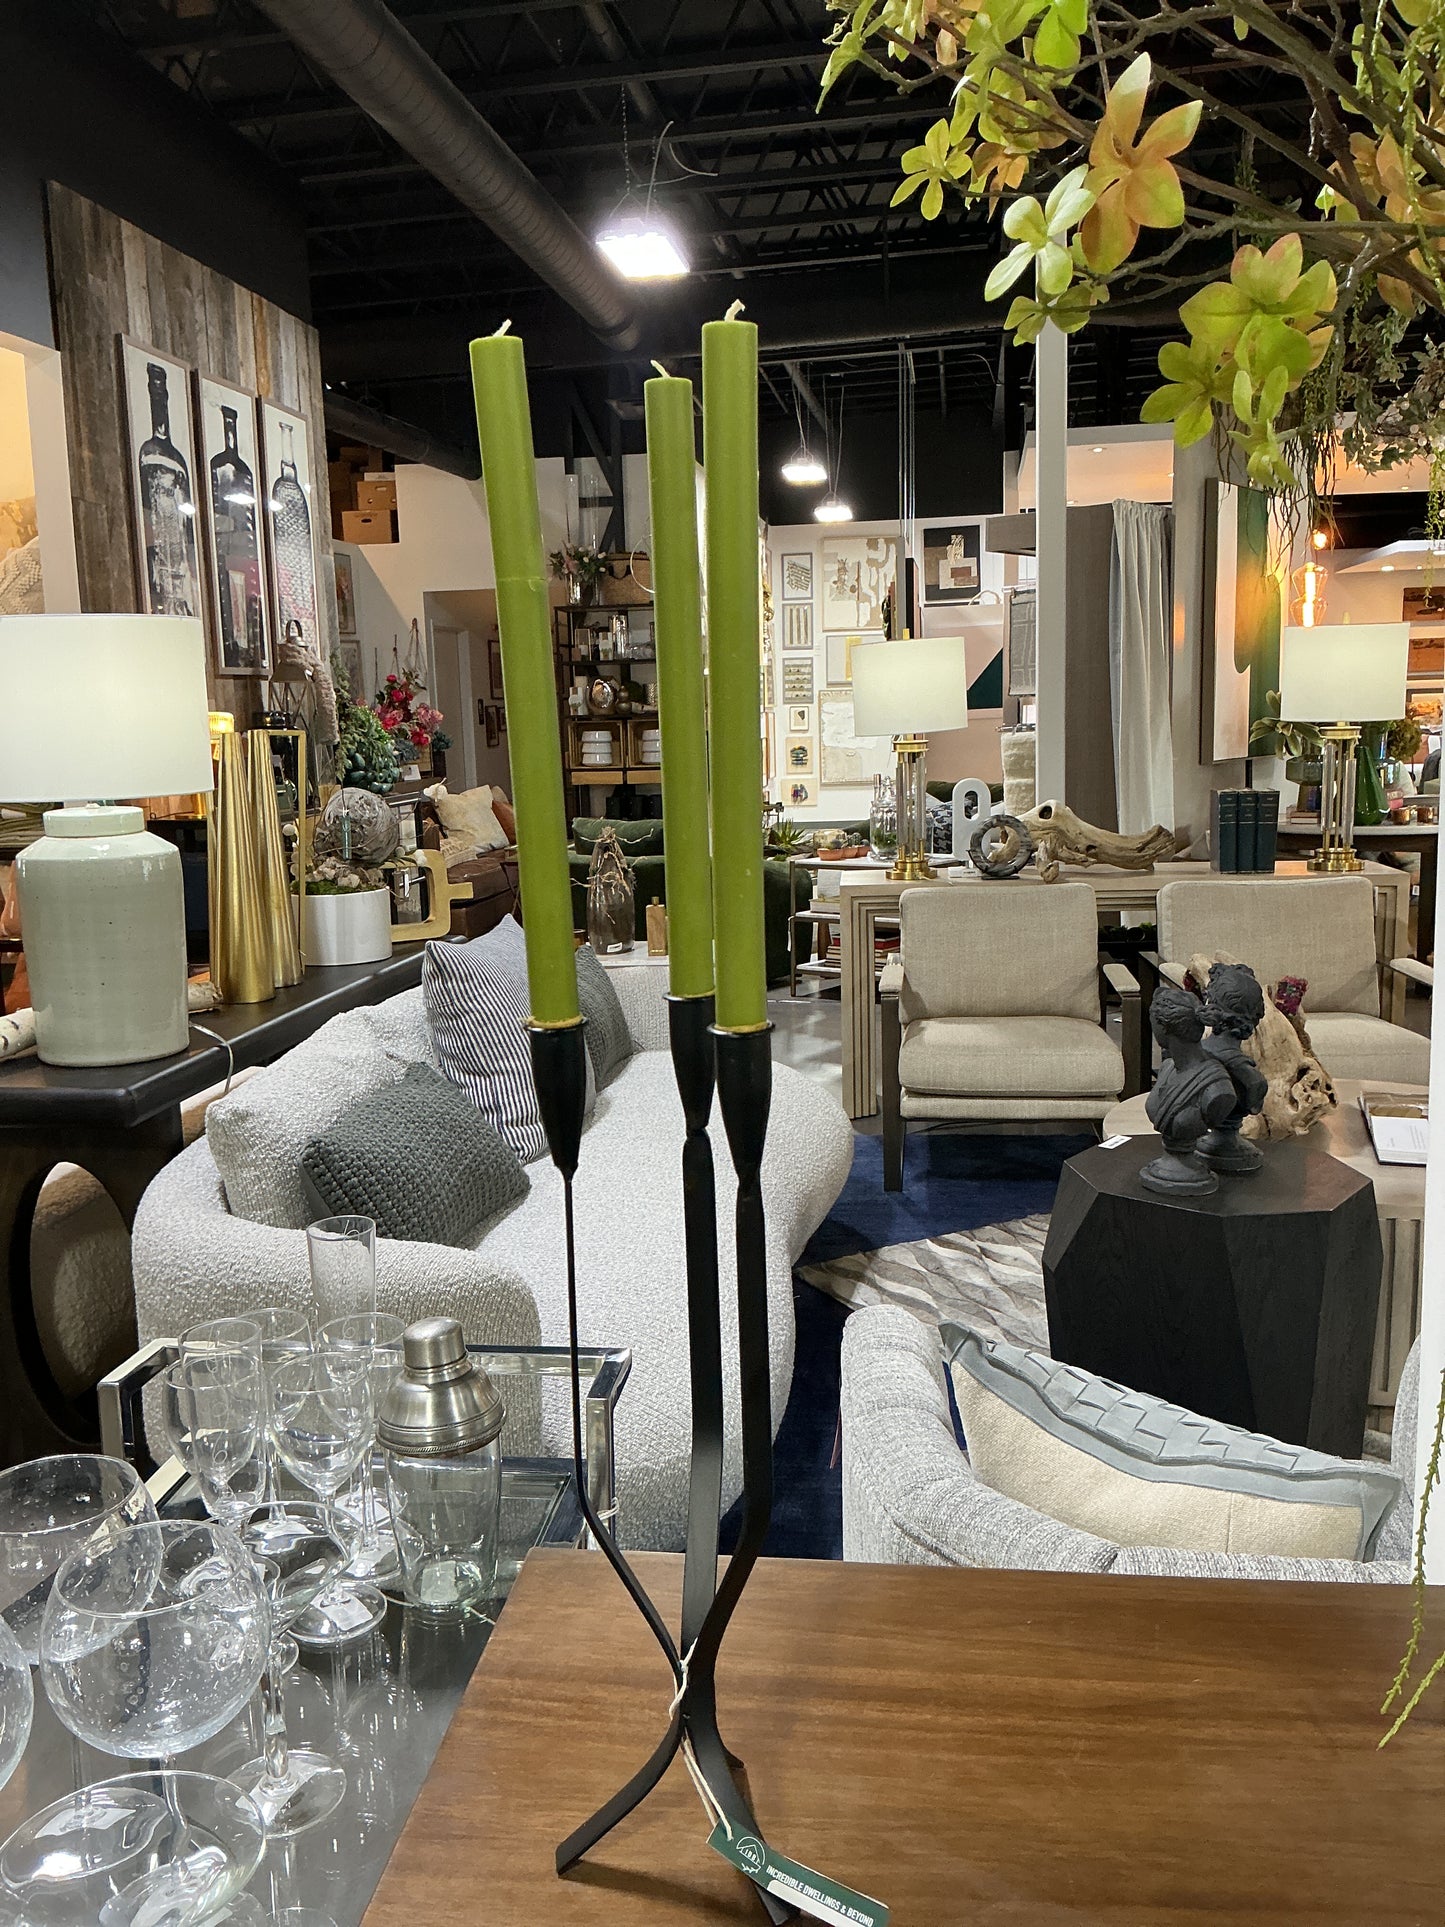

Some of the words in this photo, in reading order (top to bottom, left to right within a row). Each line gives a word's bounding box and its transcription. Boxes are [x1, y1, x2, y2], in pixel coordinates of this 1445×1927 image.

[766, 1864, 804, 1891] INCREDIBLE
[802, 1884, 841, 1911] DWELLINGS
[839, 1904, 847, 1914] &
[846, 1907, 875, 1927] BEYOND
